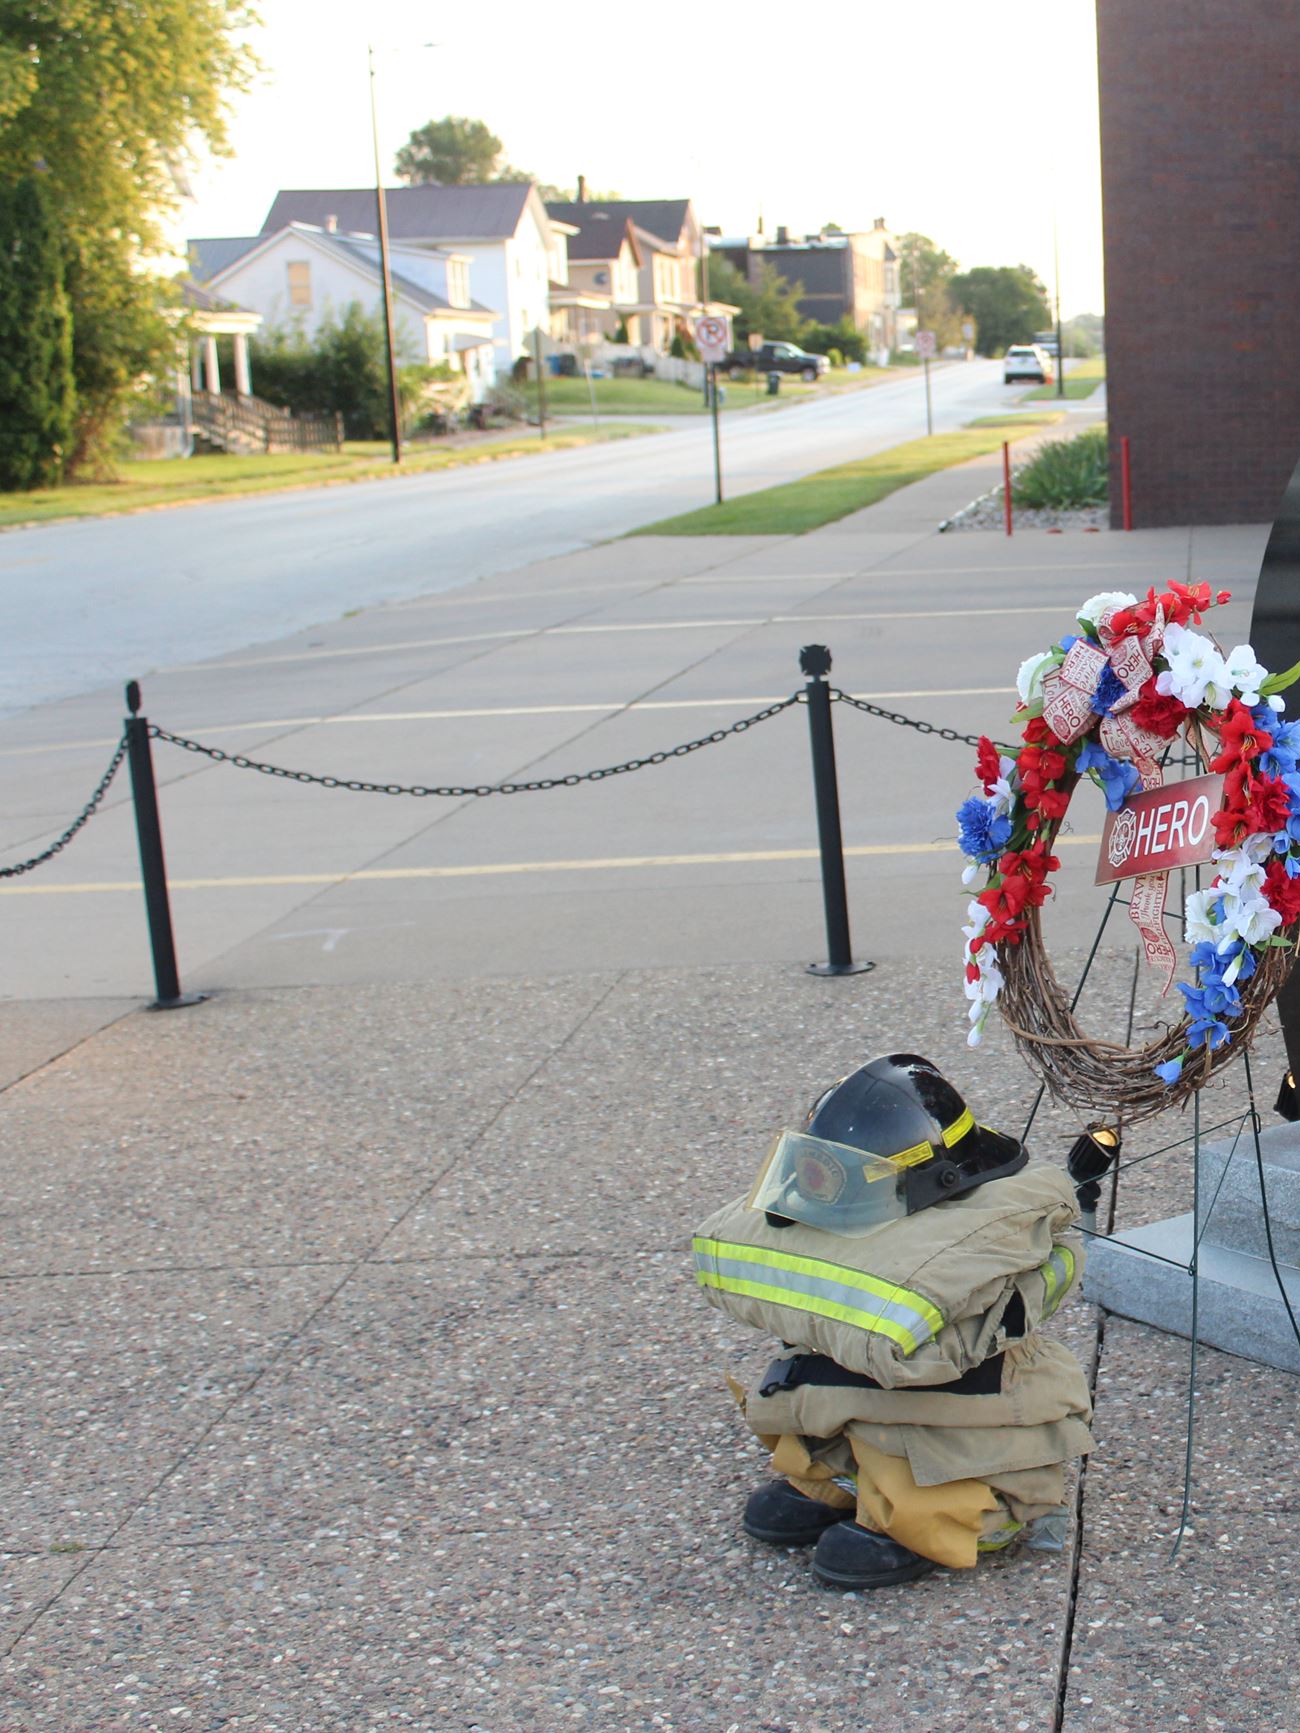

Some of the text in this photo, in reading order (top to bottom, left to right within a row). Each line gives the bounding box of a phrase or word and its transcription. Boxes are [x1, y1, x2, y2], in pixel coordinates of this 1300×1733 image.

[1117, 650, 1144, 679] HERO
[1058, 695, 1081, 728] HERO
[1134, 795, 1209, 858] HERO
